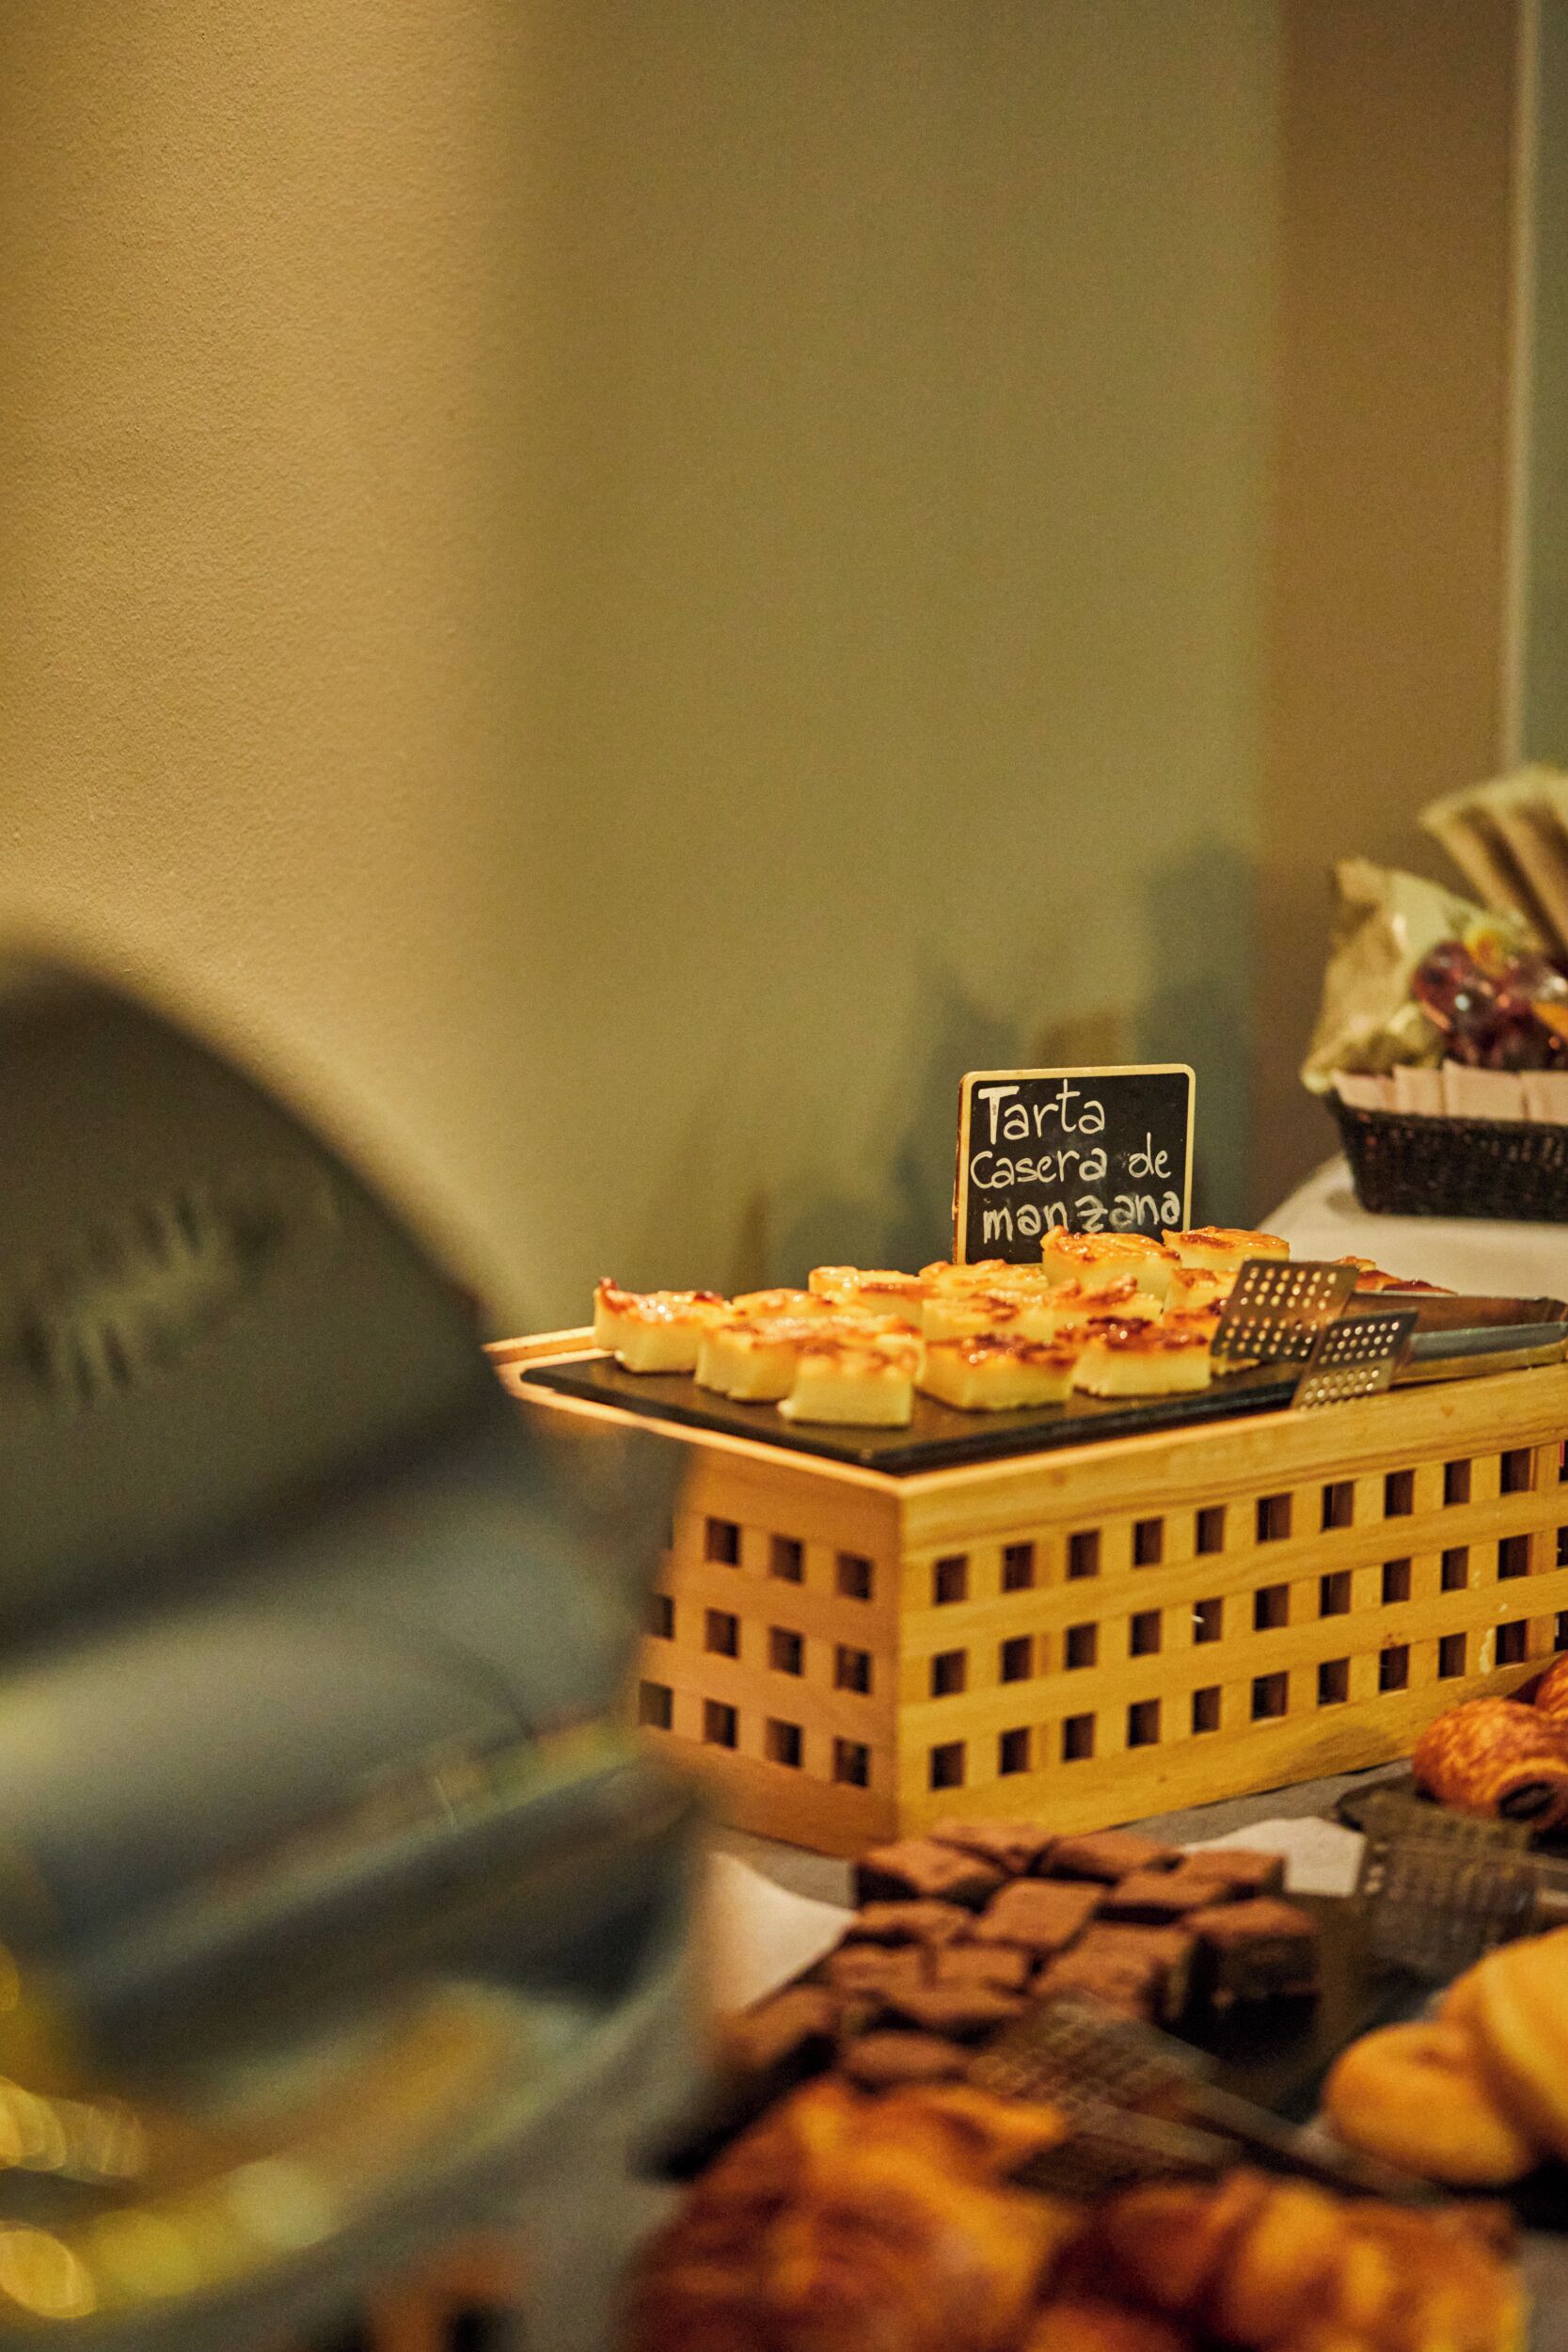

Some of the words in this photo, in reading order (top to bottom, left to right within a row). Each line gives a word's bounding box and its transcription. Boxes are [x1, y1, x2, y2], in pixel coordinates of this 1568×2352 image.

[978, 1078, 1105, 1145] Tarta
[1128, 1131, 1172, 1179] de
[983, 1190, 1180, 1244] manzana
